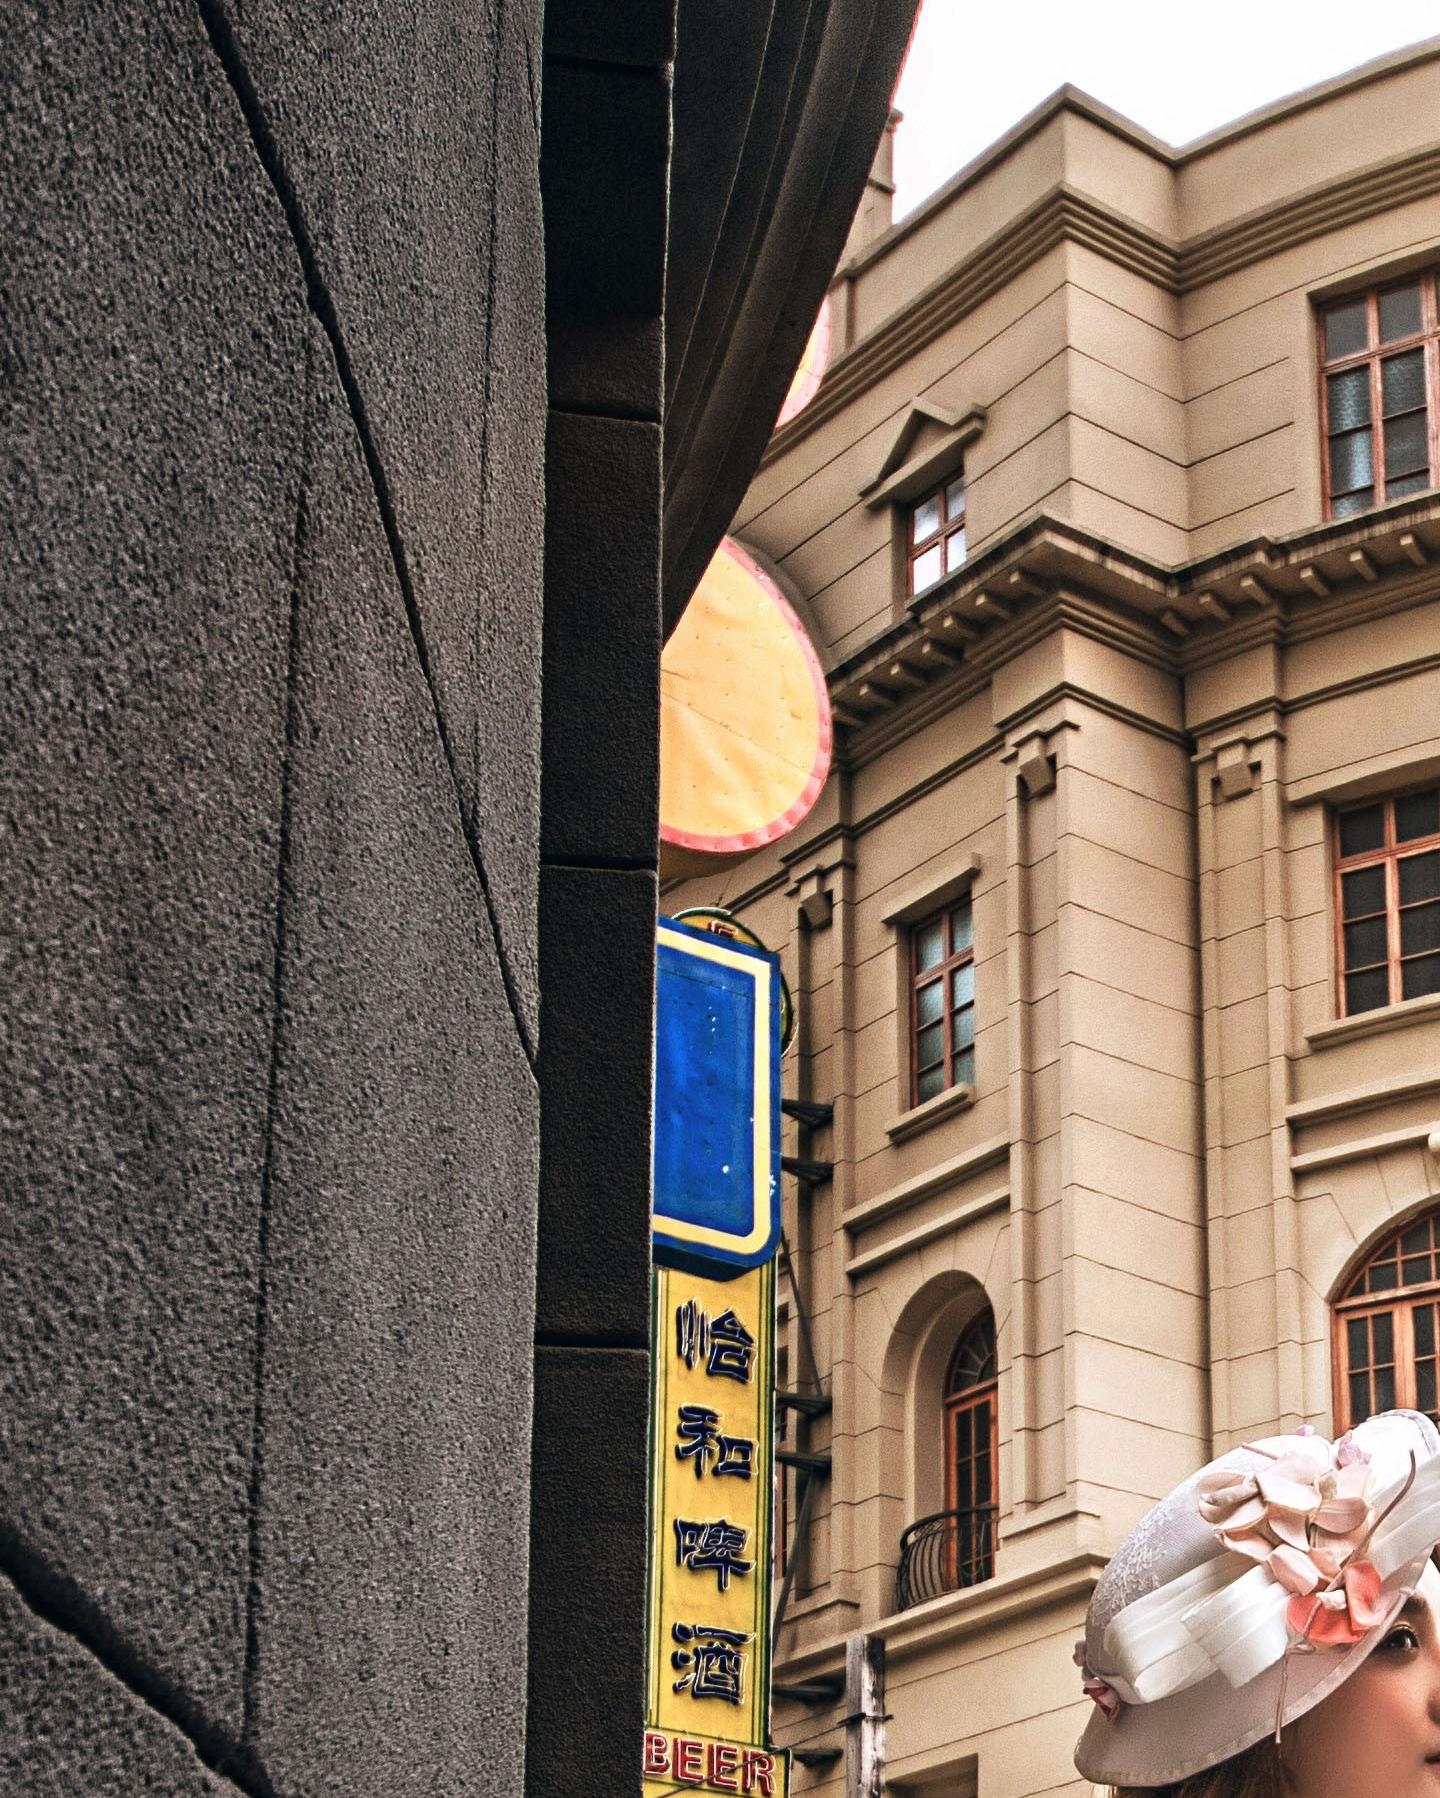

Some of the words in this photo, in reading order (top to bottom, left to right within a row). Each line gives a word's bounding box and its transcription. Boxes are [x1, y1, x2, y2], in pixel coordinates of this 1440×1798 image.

[671, 1296, 760, 1705] 怡和啤酒
[644, 1731, 777, 1798] BEER
